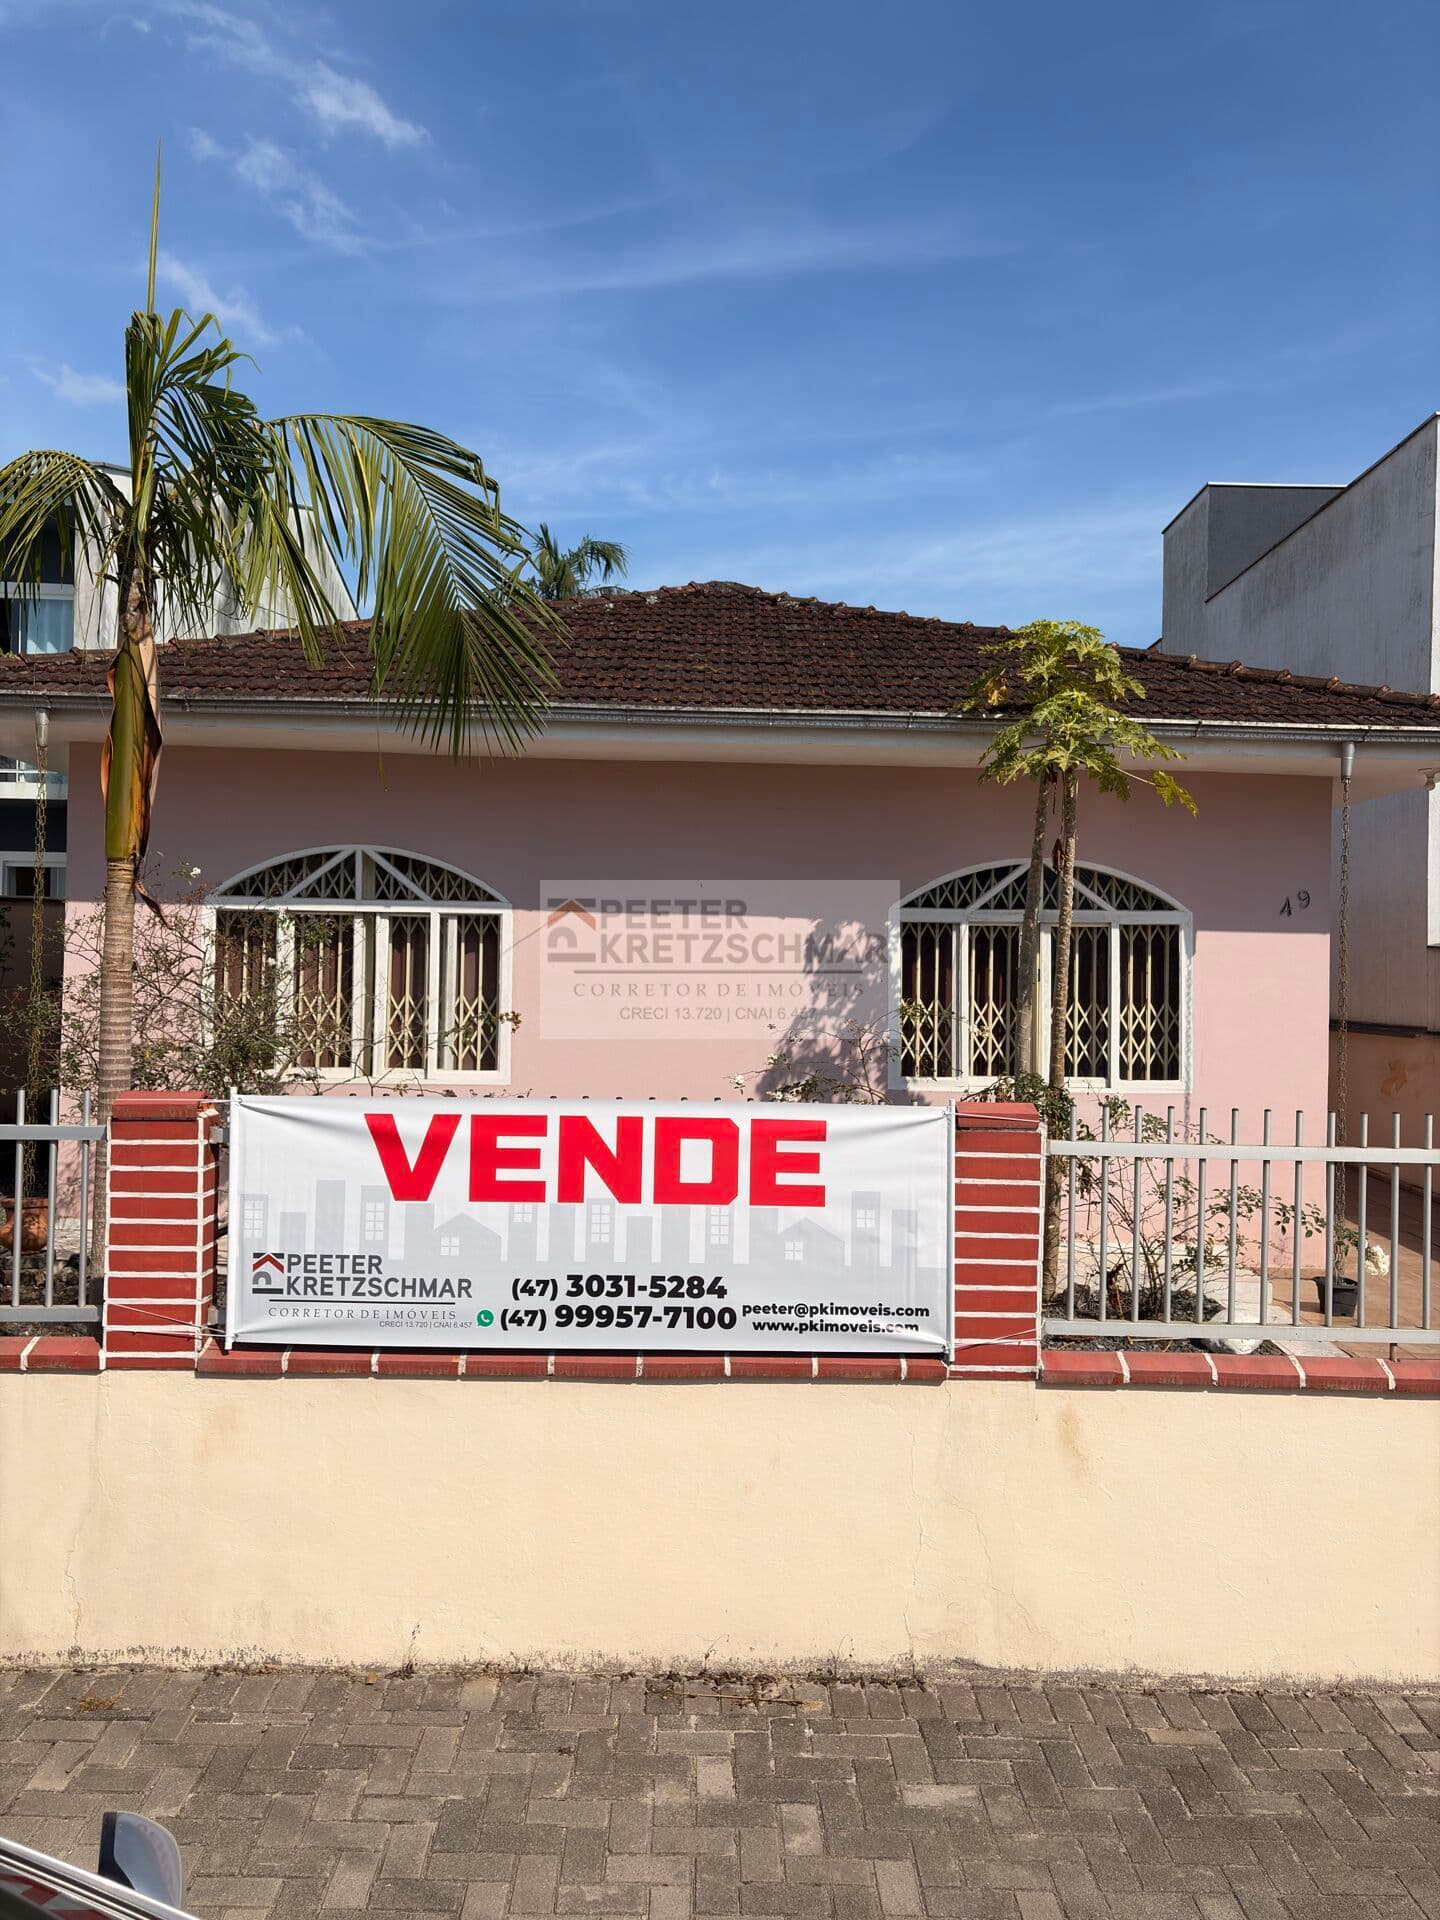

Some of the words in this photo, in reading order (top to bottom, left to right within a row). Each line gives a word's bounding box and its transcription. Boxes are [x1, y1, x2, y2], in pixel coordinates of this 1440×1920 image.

[364, 1113, 827, 1207] VENDE
[286, 1253, 383, 1275] PEETER
[286, 1276, 473, 1298] KRETZSCHMAR
[512, 1278, 558, 1300] (47)
[565, 1274, 728, 1299] 3031-5284
[268, 1307, 354, 1319] CORRETOR
[361, 1310, 380, 1319] DE
[386, 1308, 457, 1320] IMÓVEIS
[500, 1308, 547, 1331] (47)
[554, 1305, 738, 1330] 99957-7100
[742, 1302, 930, 1318] peeter@pkimoveis.com
[433, 1321, 452, 1329] CNAI
[752, 1319, 919, 1334] www.pkimoveis.com
